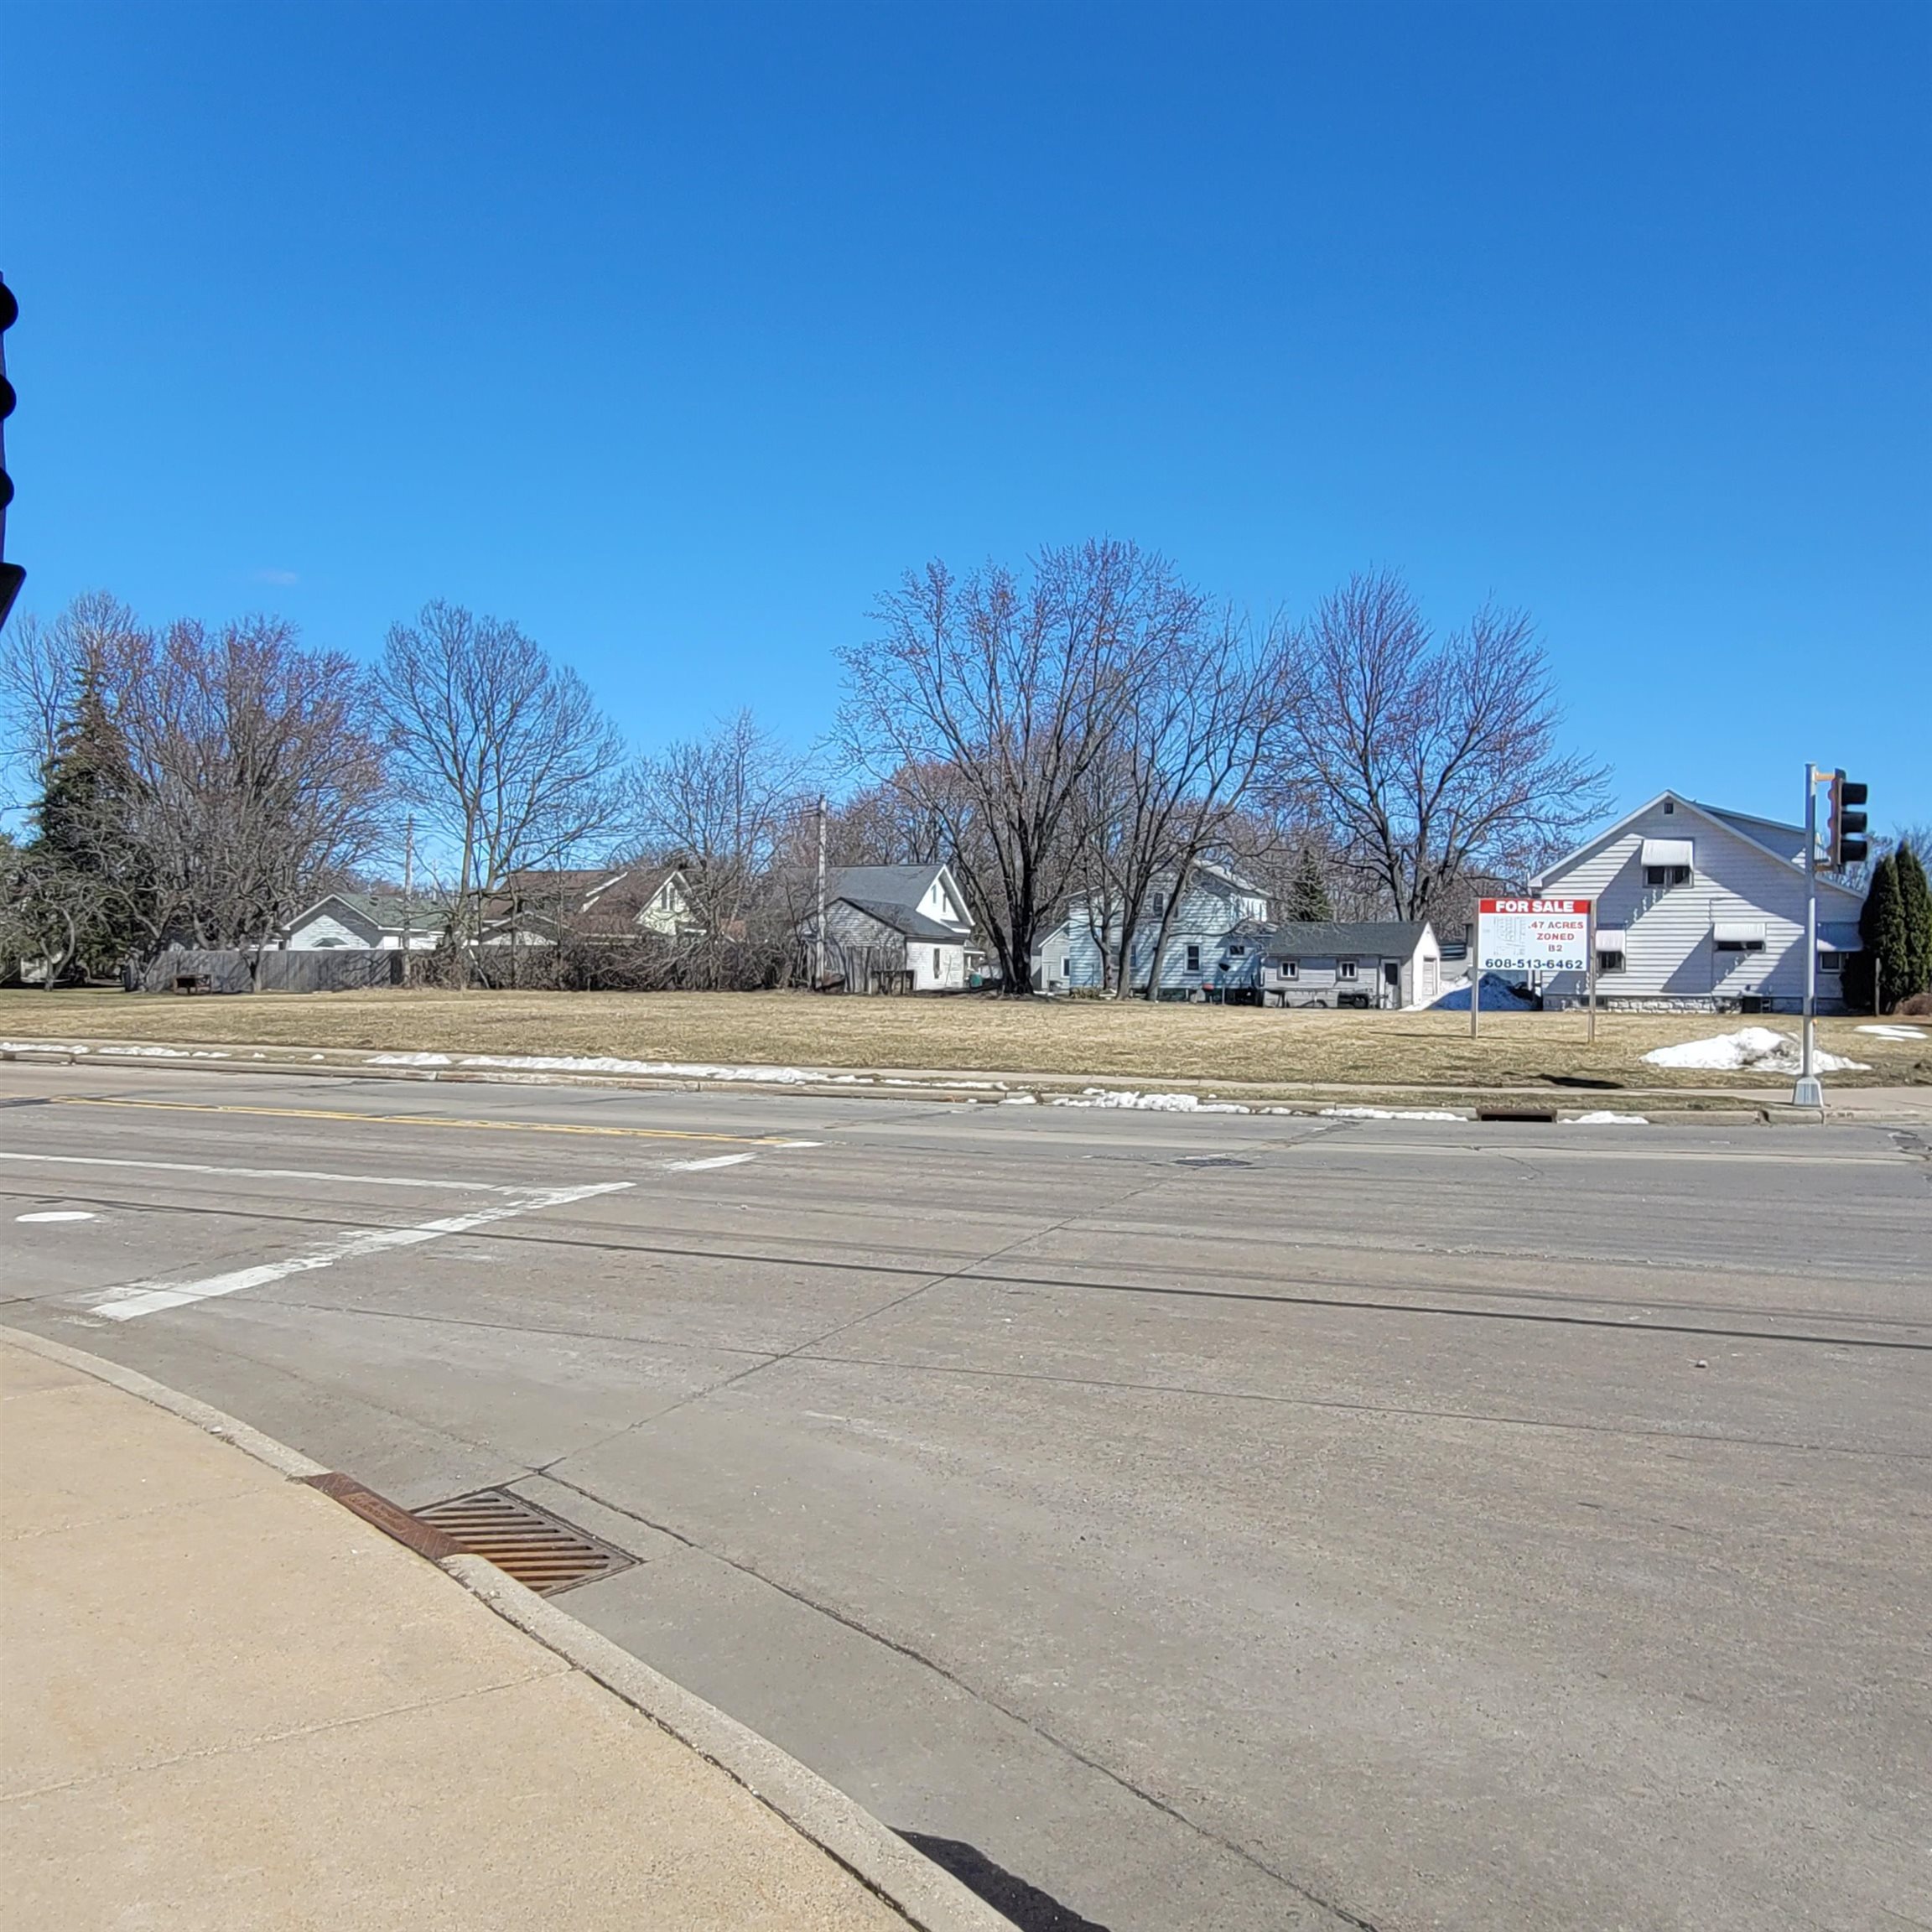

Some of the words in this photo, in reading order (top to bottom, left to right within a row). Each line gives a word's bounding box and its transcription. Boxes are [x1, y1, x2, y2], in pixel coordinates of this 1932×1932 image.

[1496, 901, 1529, 912] FOR
[1532, 901, 1574, 912] SALE
[1485, 959, 1583, 969] 608-513-6462
